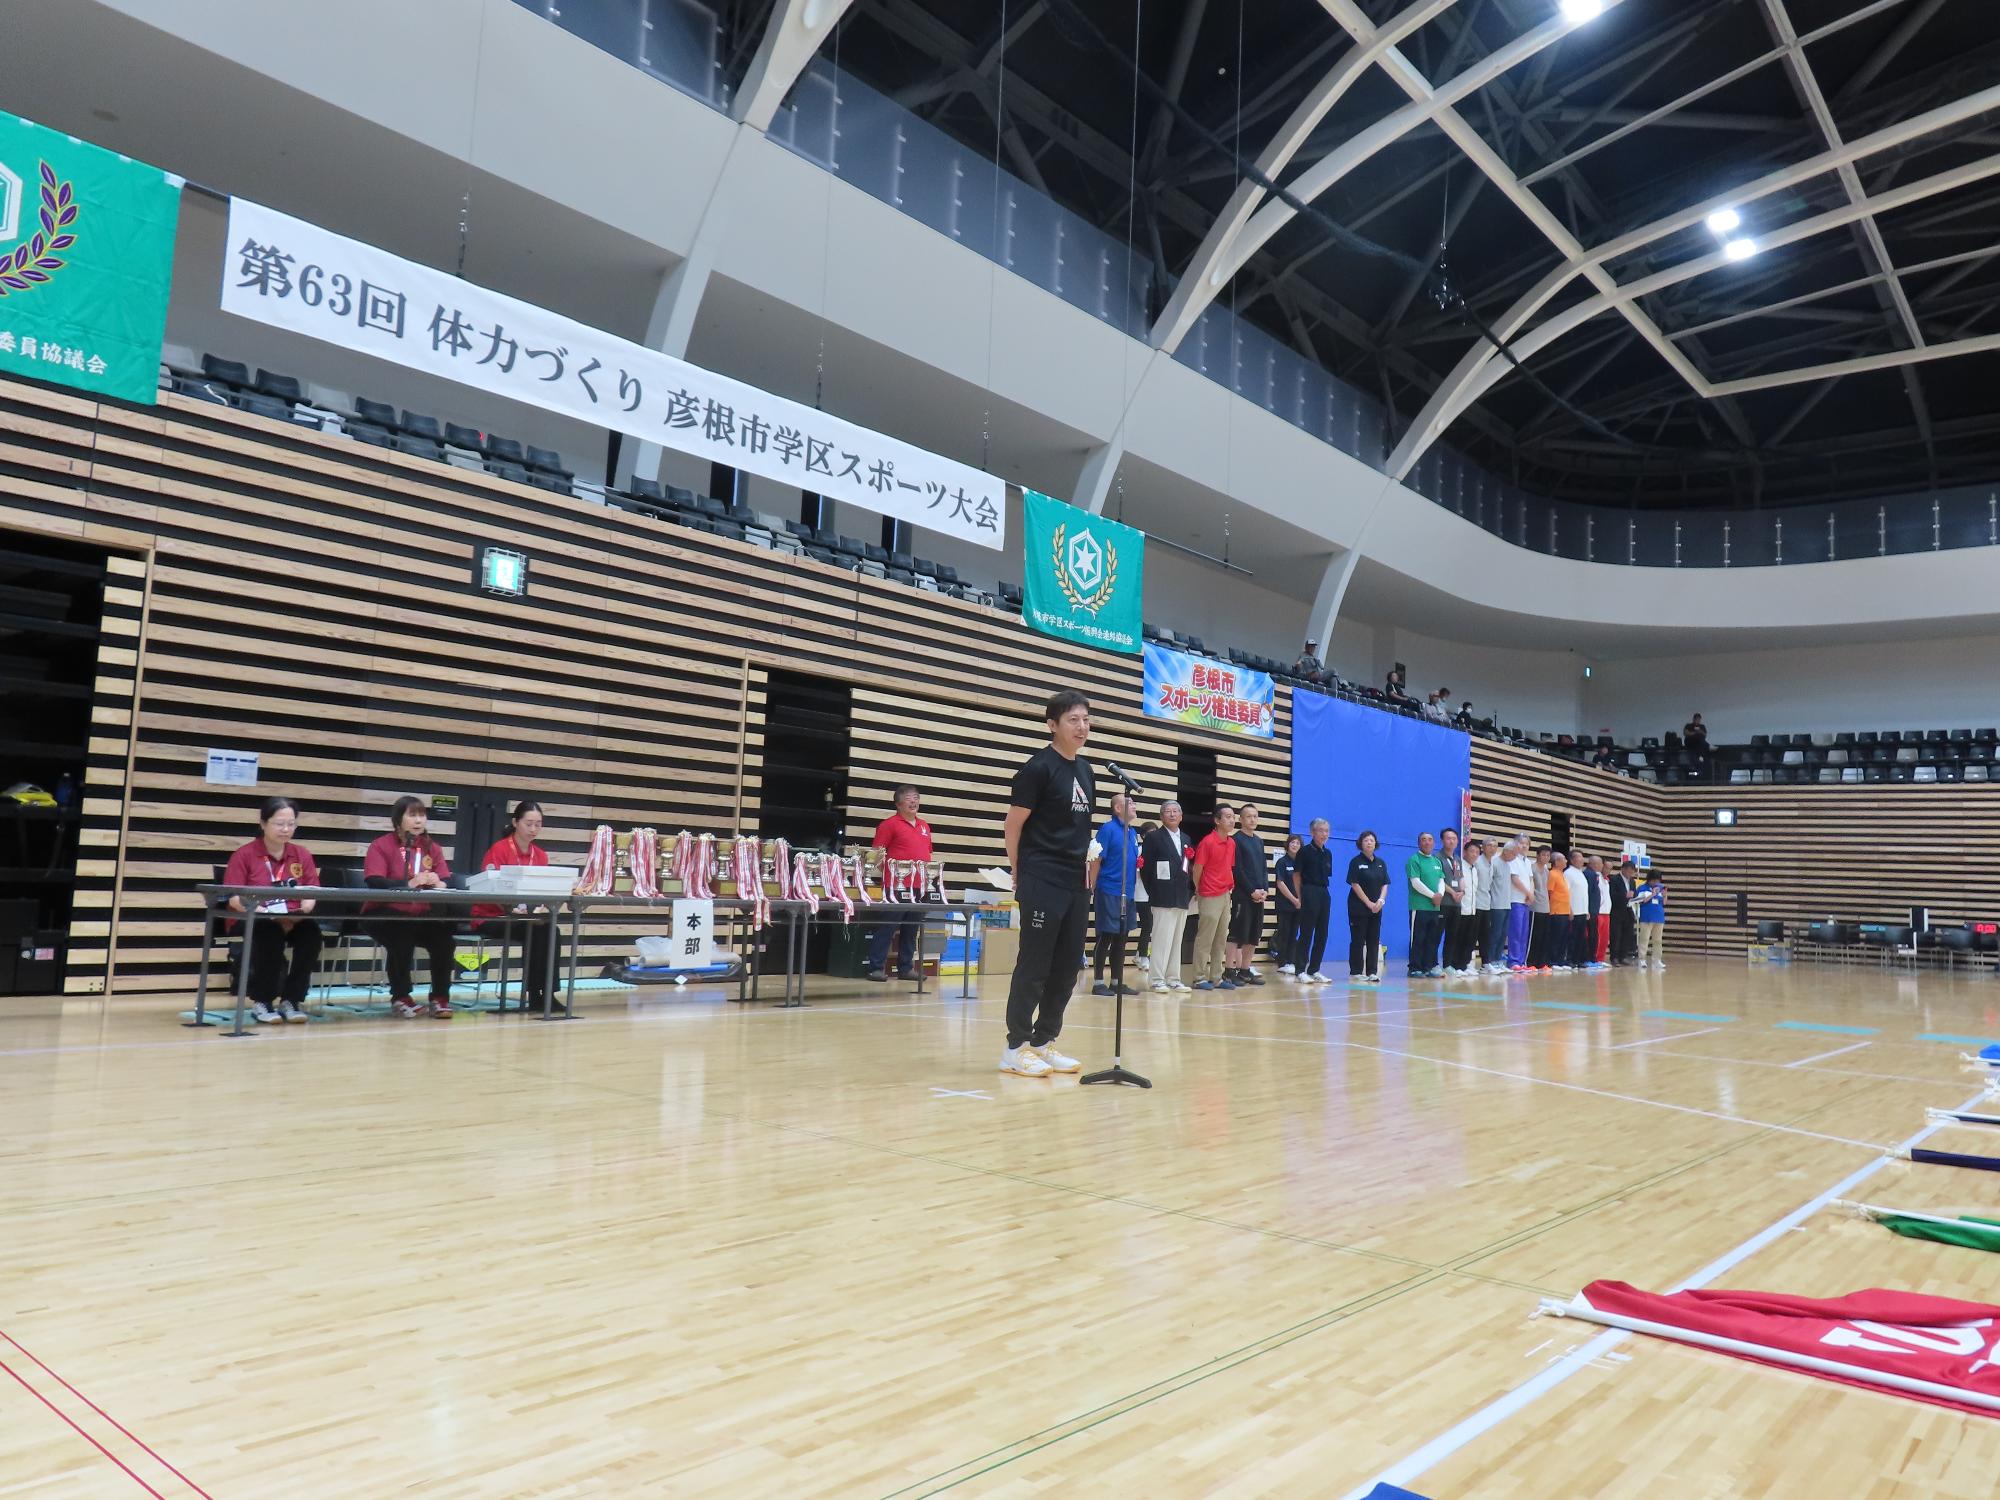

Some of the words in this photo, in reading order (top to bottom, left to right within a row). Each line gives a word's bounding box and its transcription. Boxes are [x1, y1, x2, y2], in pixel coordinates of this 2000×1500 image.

[236, 237, 407, 339] 第63回
[427, 303, 642, 412] 体力づくり
[663, 388, 1000, 534] 彦根市学区スポーツ大会
[1191, 663, 1236, 695] 彦根市
[1159, 683, 1262, 727] スポーツ推進委員
[684, 912, 702, 956] 本部
